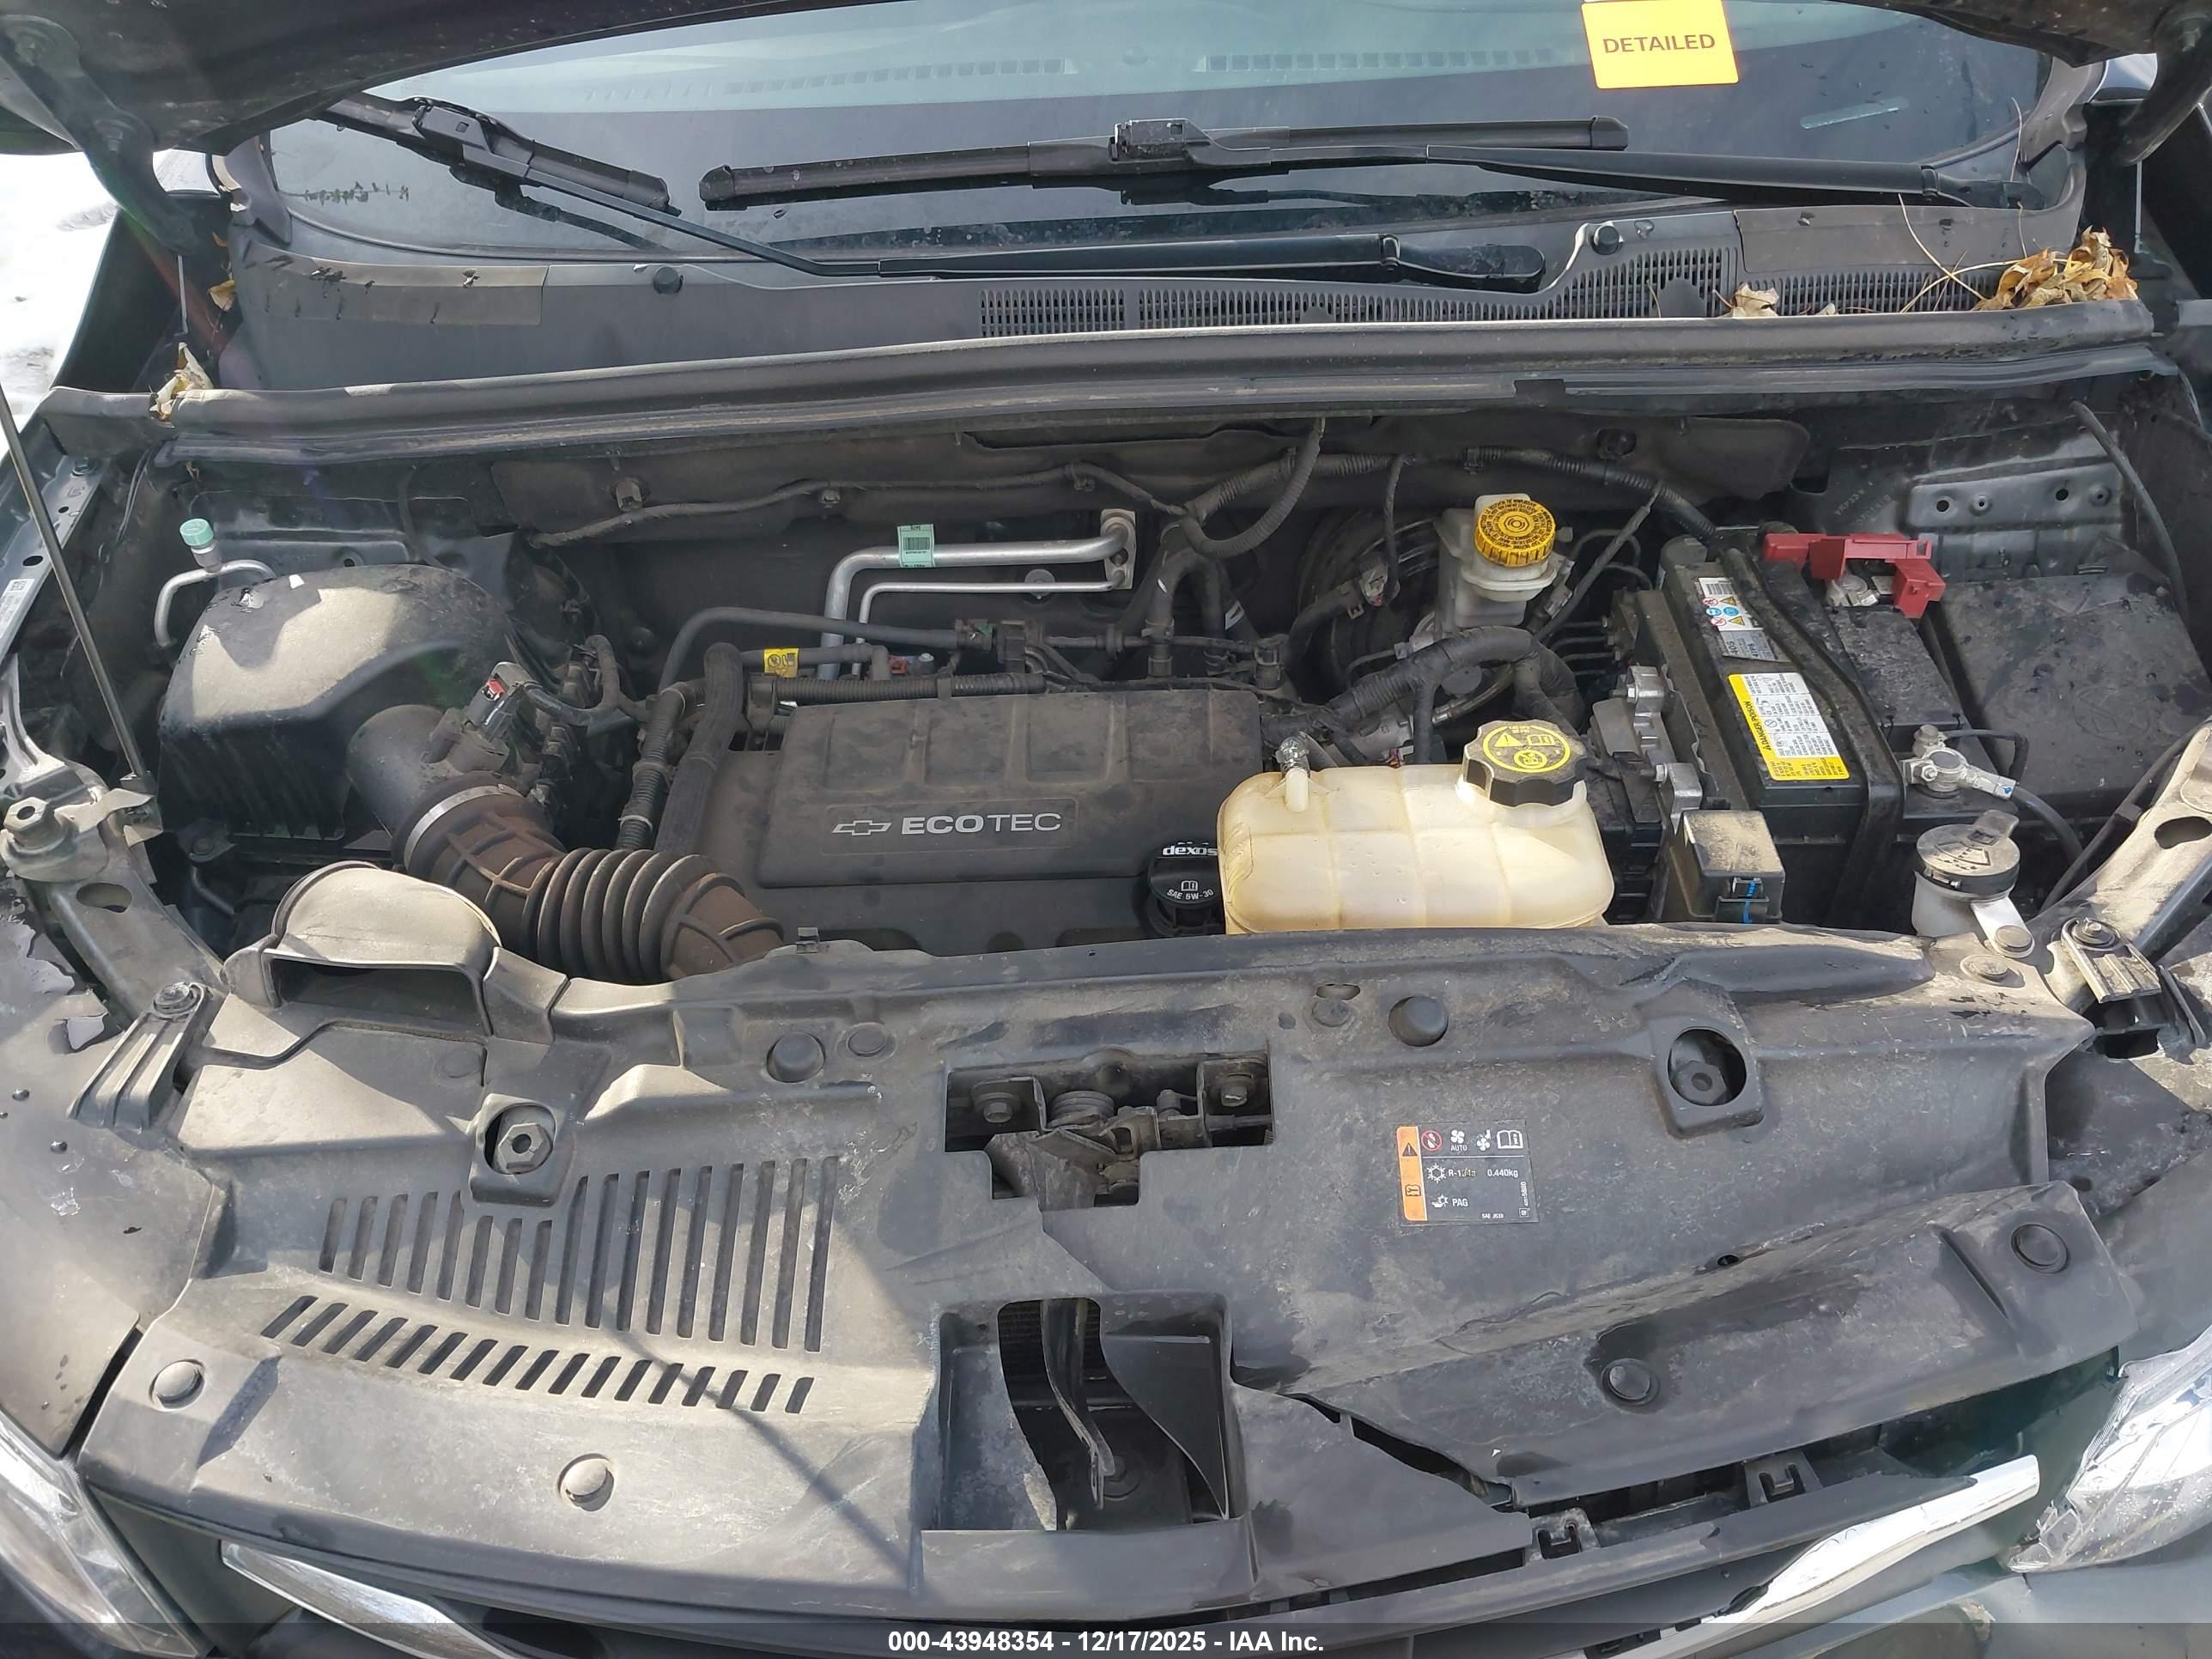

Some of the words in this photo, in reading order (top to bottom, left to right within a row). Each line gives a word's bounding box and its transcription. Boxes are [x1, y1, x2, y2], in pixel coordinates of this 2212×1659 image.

[1602, 34, 1716, 53] DETAILED
[901, 813, 1062, 835] ECOTEC
[1162, 845, 1218, 856] dexos
[1167, 889, 1183, 900] SAE
[1185, 889, 1214, 901] 5W-30
[1486, 1169, 1519, 1178] 0.440kg
[1452, 1198, 1468, 1207] PAG
